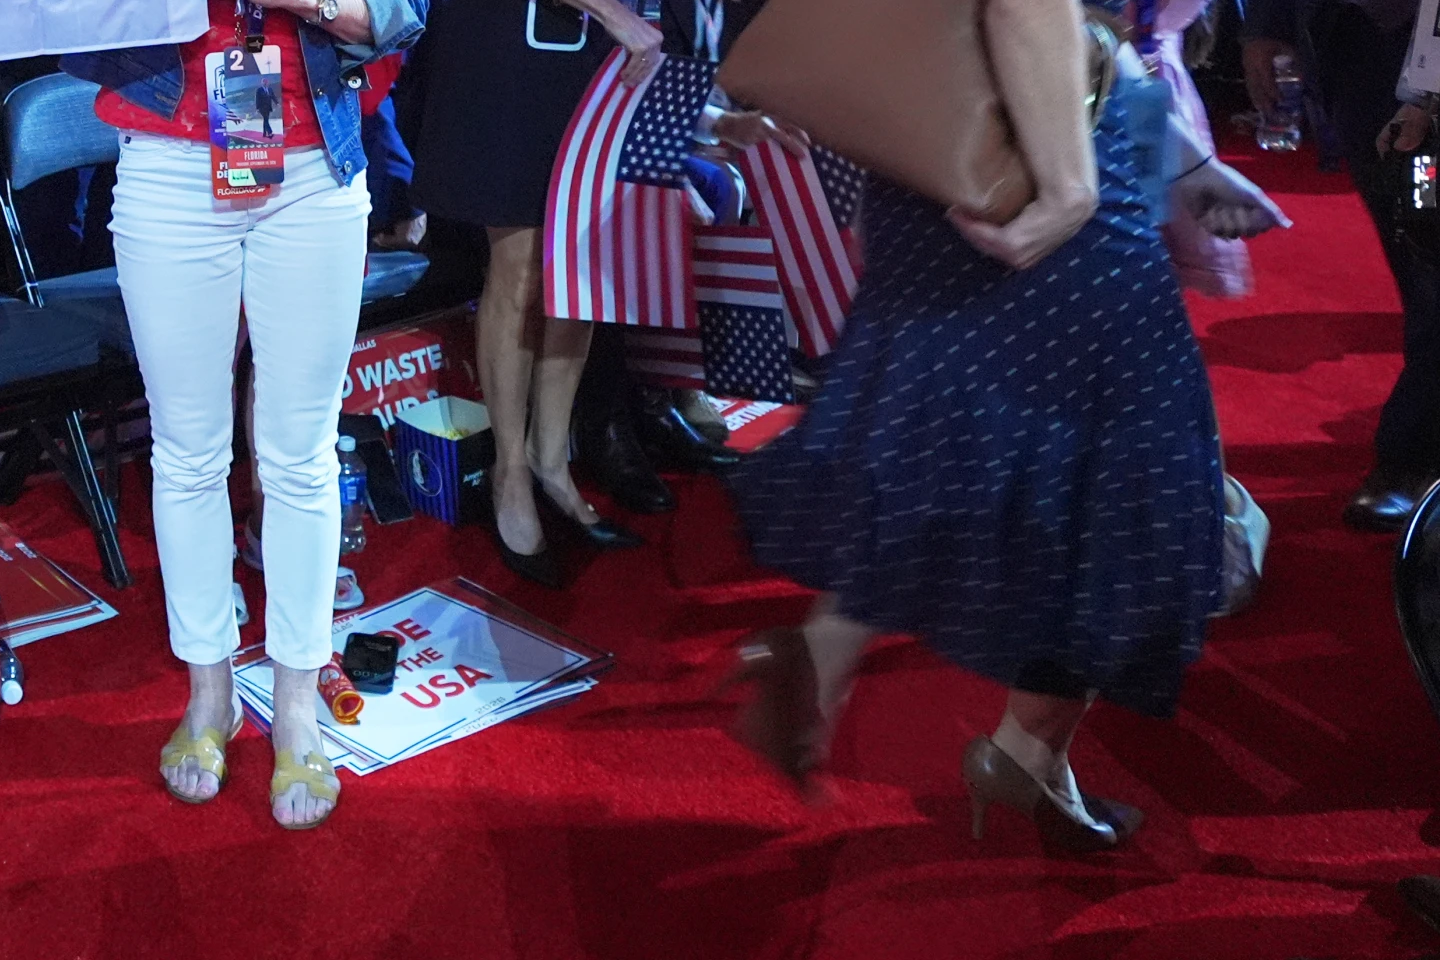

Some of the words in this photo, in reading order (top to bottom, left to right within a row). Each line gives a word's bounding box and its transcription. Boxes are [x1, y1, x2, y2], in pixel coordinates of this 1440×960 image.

[229, 50, 244, 71] 2
[244, 151, 268, 160] FLORIDA
[352, 340, 377, 353] ALLAS
[356, 344, 442, 392] WASTE
[396, 646, 444, 672] THE
[400, 664, 494, 709] USA
